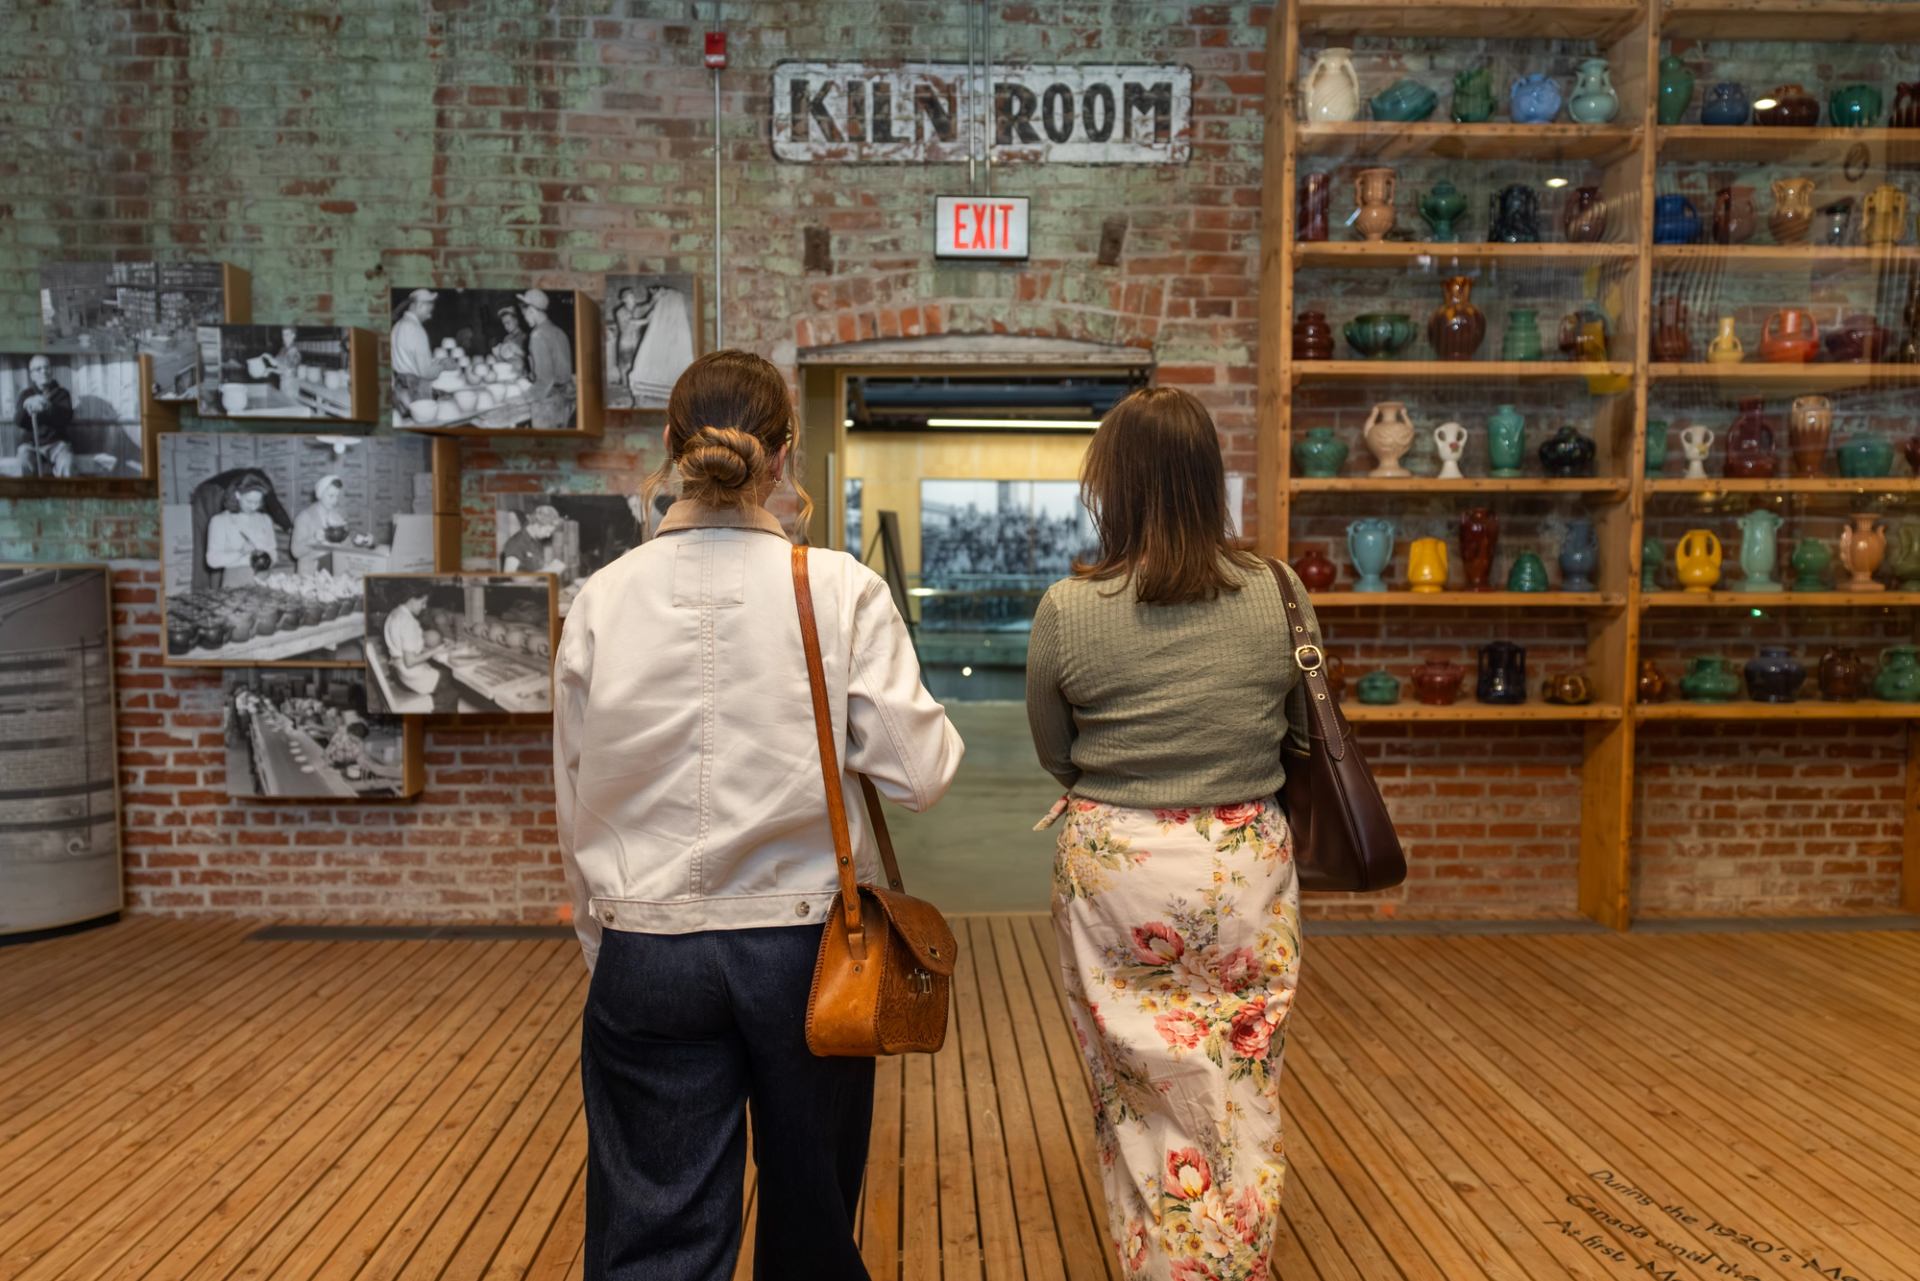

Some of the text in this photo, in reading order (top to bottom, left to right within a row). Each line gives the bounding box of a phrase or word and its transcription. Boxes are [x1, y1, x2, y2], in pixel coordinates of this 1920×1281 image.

[790, 78, 1173, 145] KILN ROOM
[953, 204, 1014, 249] EXIT
[1565, 1193, 1650, 1240] Canada
[1655, 1238, 1718, 1266] until
[1590, 1169, 1654, 1206] During
[1661, 1204, 1698, 1225] the
[1705, 1221, 1793, 1263] 1920's
[1543, 1220, 1581, 1237] At
[1635, 1260, 1684, 1281] M
